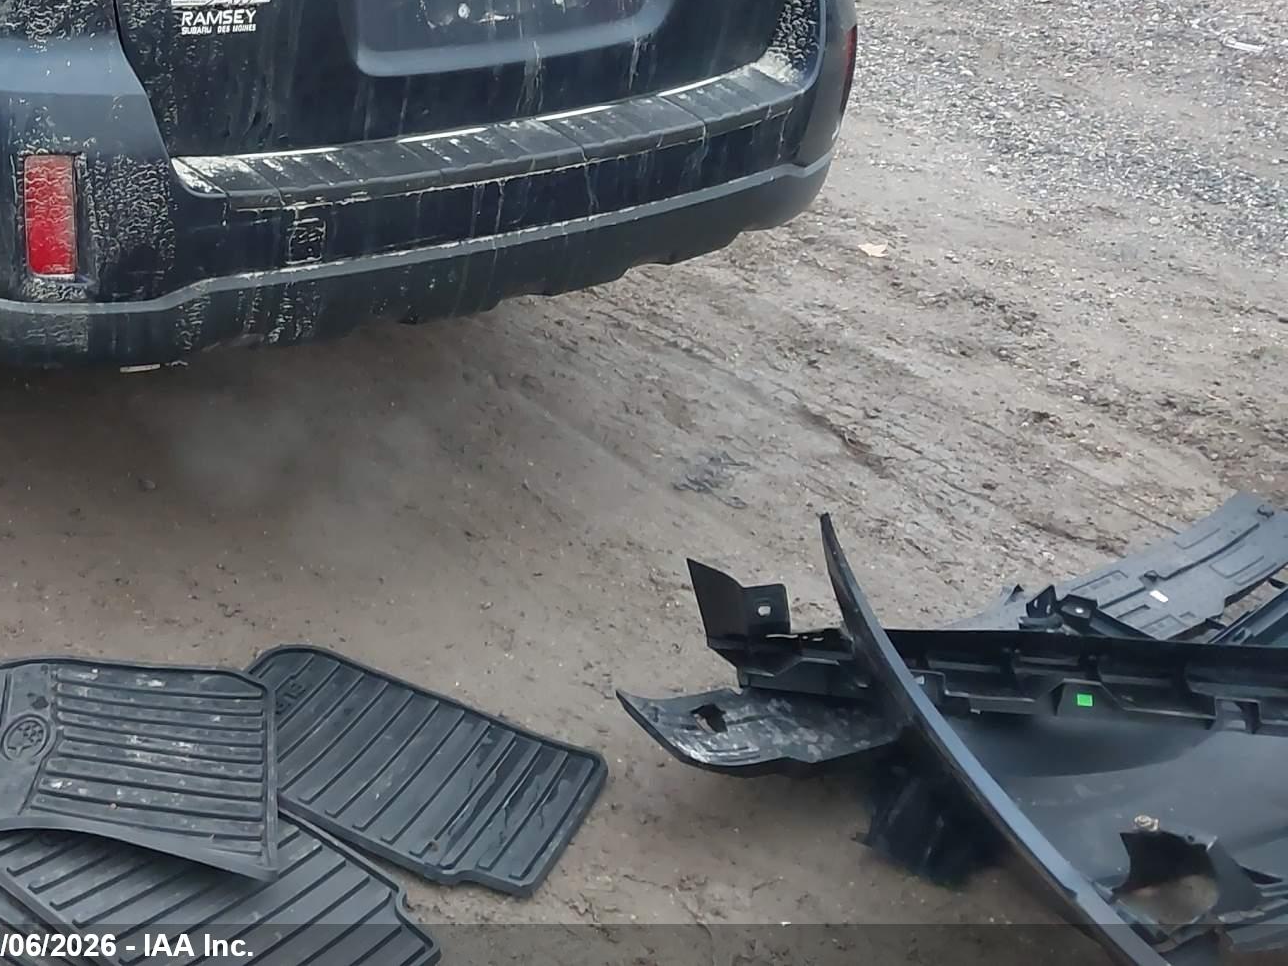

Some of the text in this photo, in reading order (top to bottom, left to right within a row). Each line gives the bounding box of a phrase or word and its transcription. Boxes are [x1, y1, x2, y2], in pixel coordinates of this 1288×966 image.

[181, 9, 257, 26] RAMSEY
[181, 23, 257, 35] SUBARU DES MOINES
